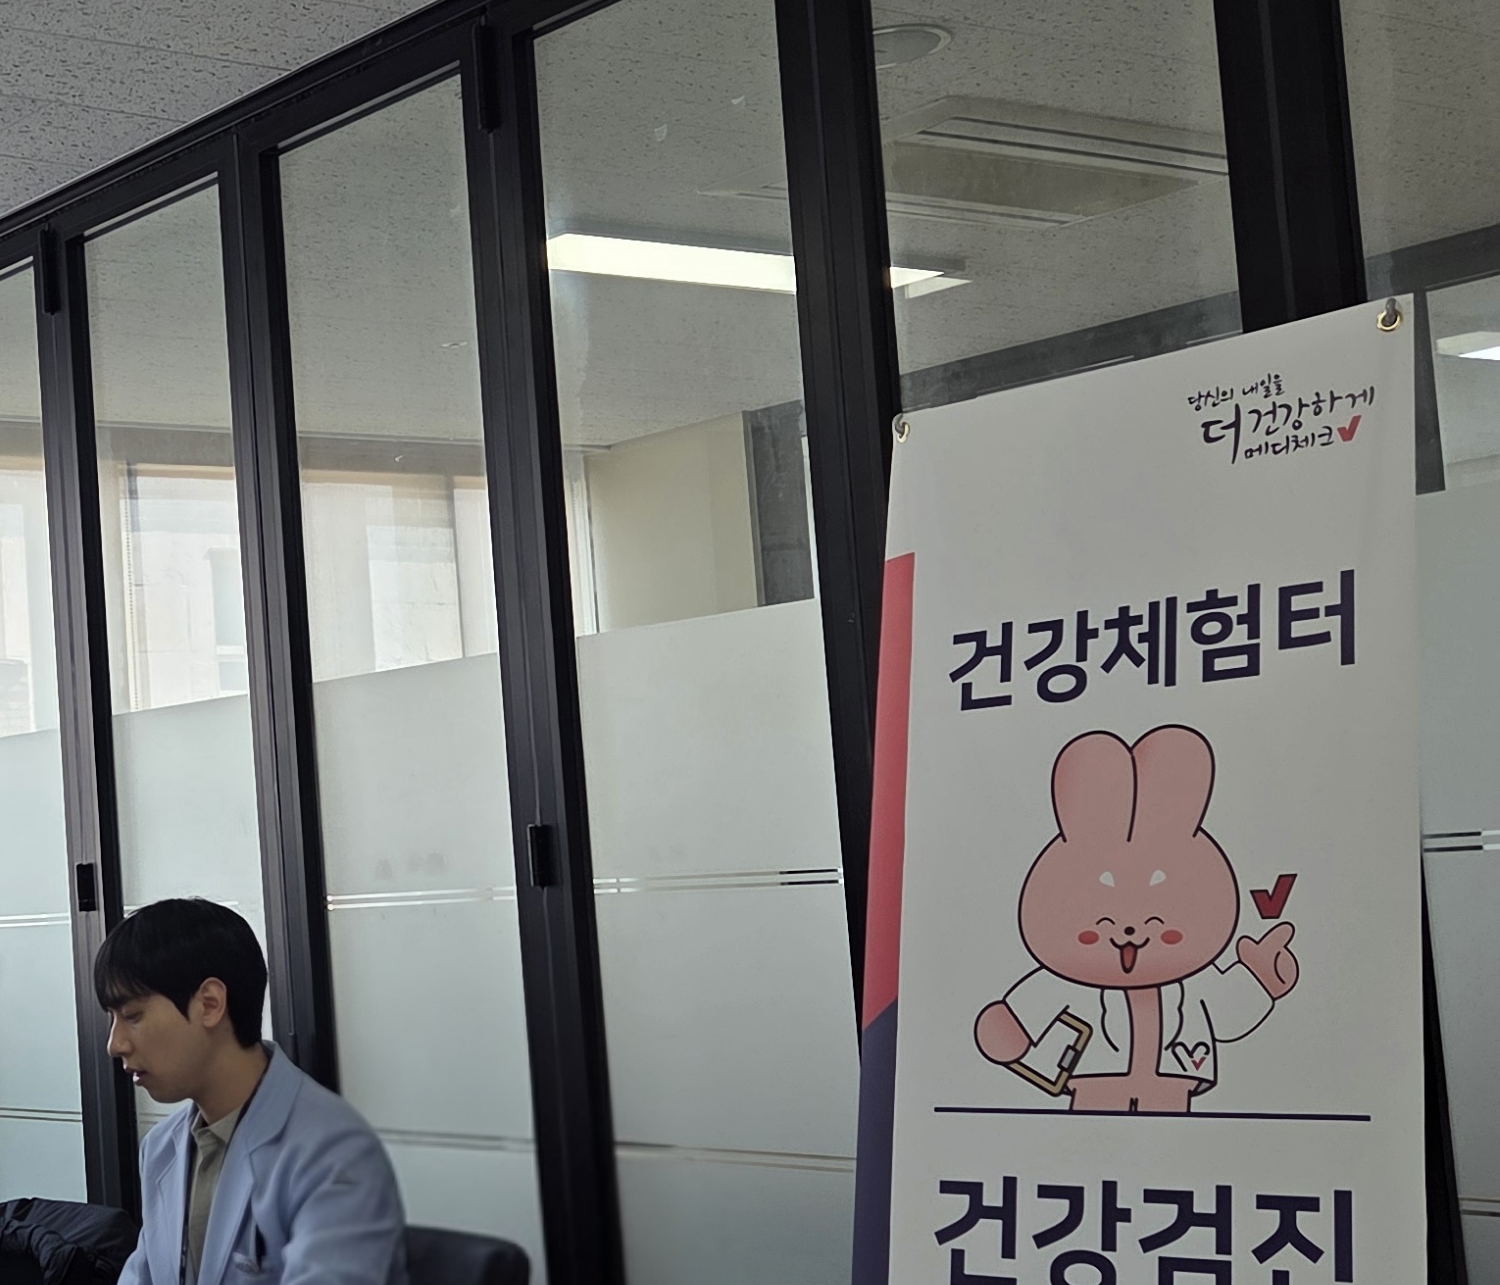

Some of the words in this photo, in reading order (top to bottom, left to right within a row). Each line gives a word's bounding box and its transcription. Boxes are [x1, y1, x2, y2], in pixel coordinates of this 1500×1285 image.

[1188, 386, 1234, 411] 당신의
[1242, 373, 1285, 399] 내일을
[1201, 403, 1242, 464] 더
[1248, 386, 1375, 436] 건강하게
[1244, 426, 1335, 459] 메디체크
[948, 569, 1356, 711] 건강체험터
